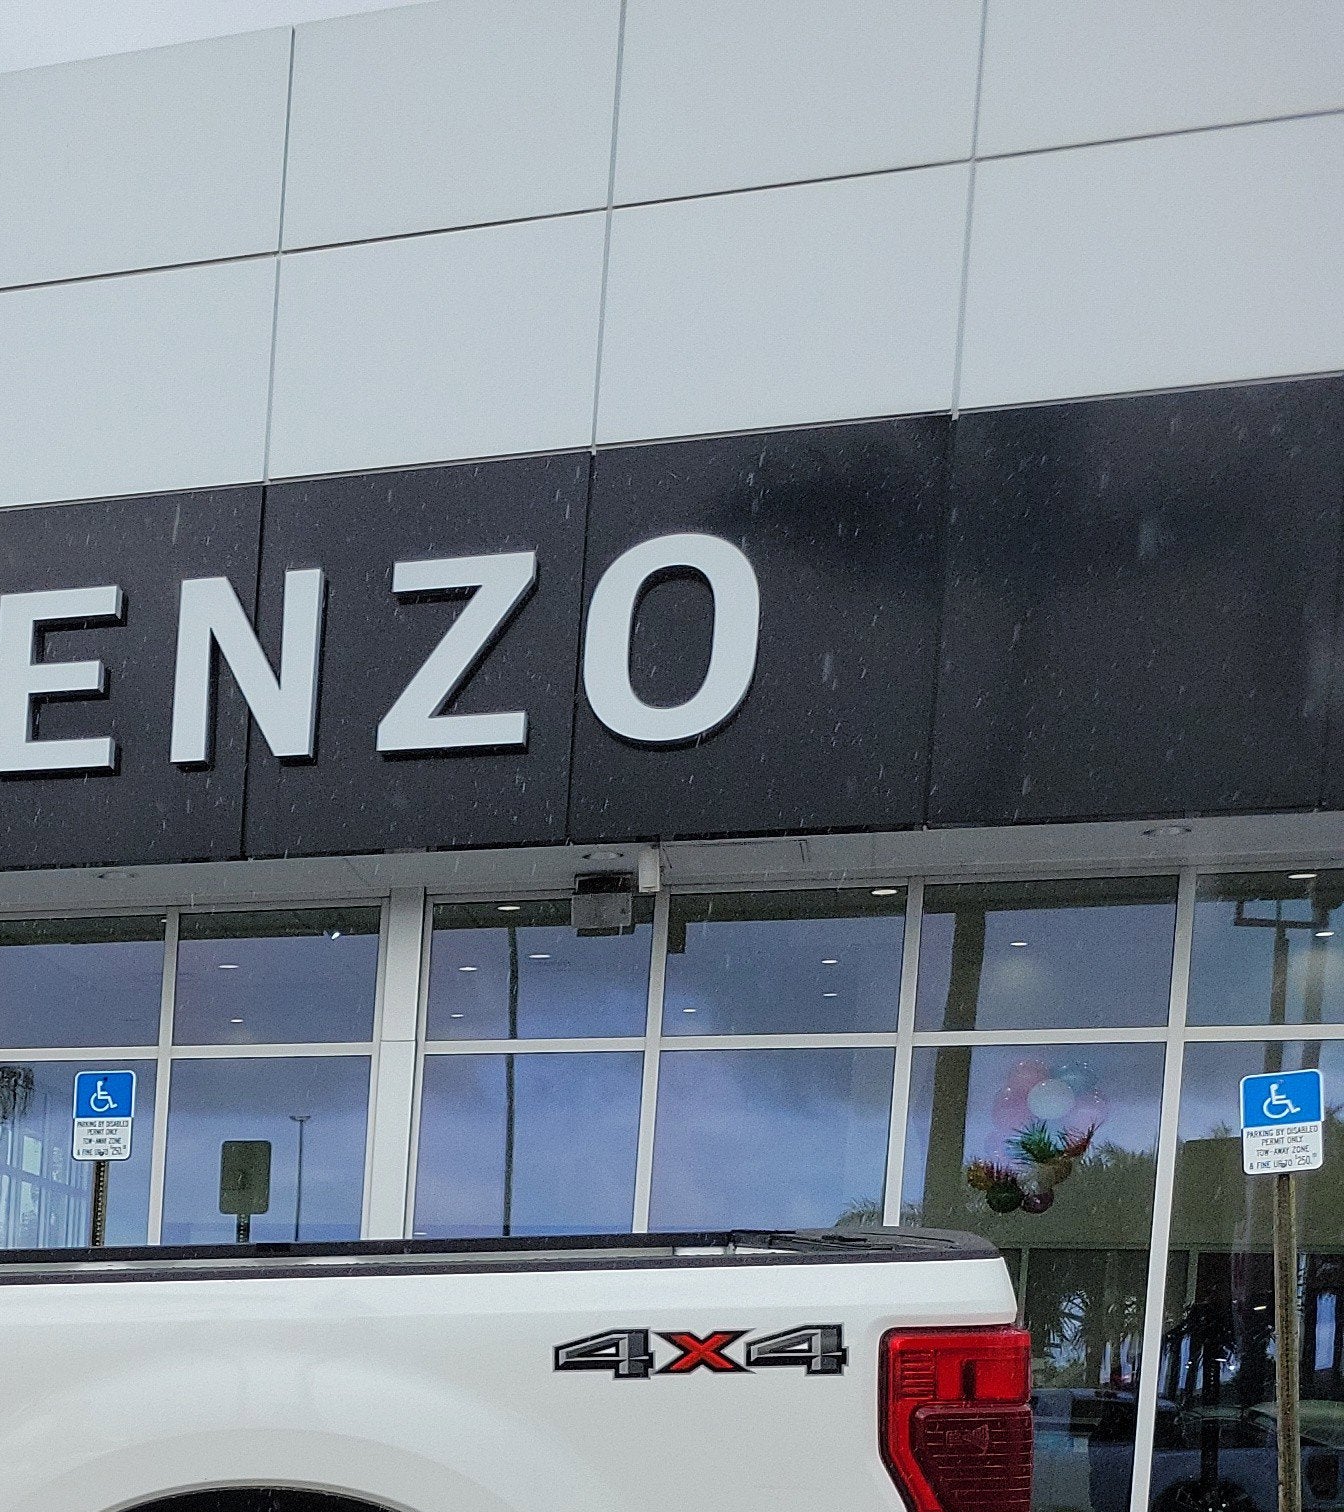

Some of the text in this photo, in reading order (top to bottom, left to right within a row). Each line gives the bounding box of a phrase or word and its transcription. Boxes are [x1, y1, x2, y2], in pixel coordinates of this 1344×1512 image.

[1246, 1125, 1318, 1138] PARKING BY DISABLED
[1256, 1145, 1310, 1157] TOW-AWAY ZONE
[1256, 1161, 1271, 1169] FINE
